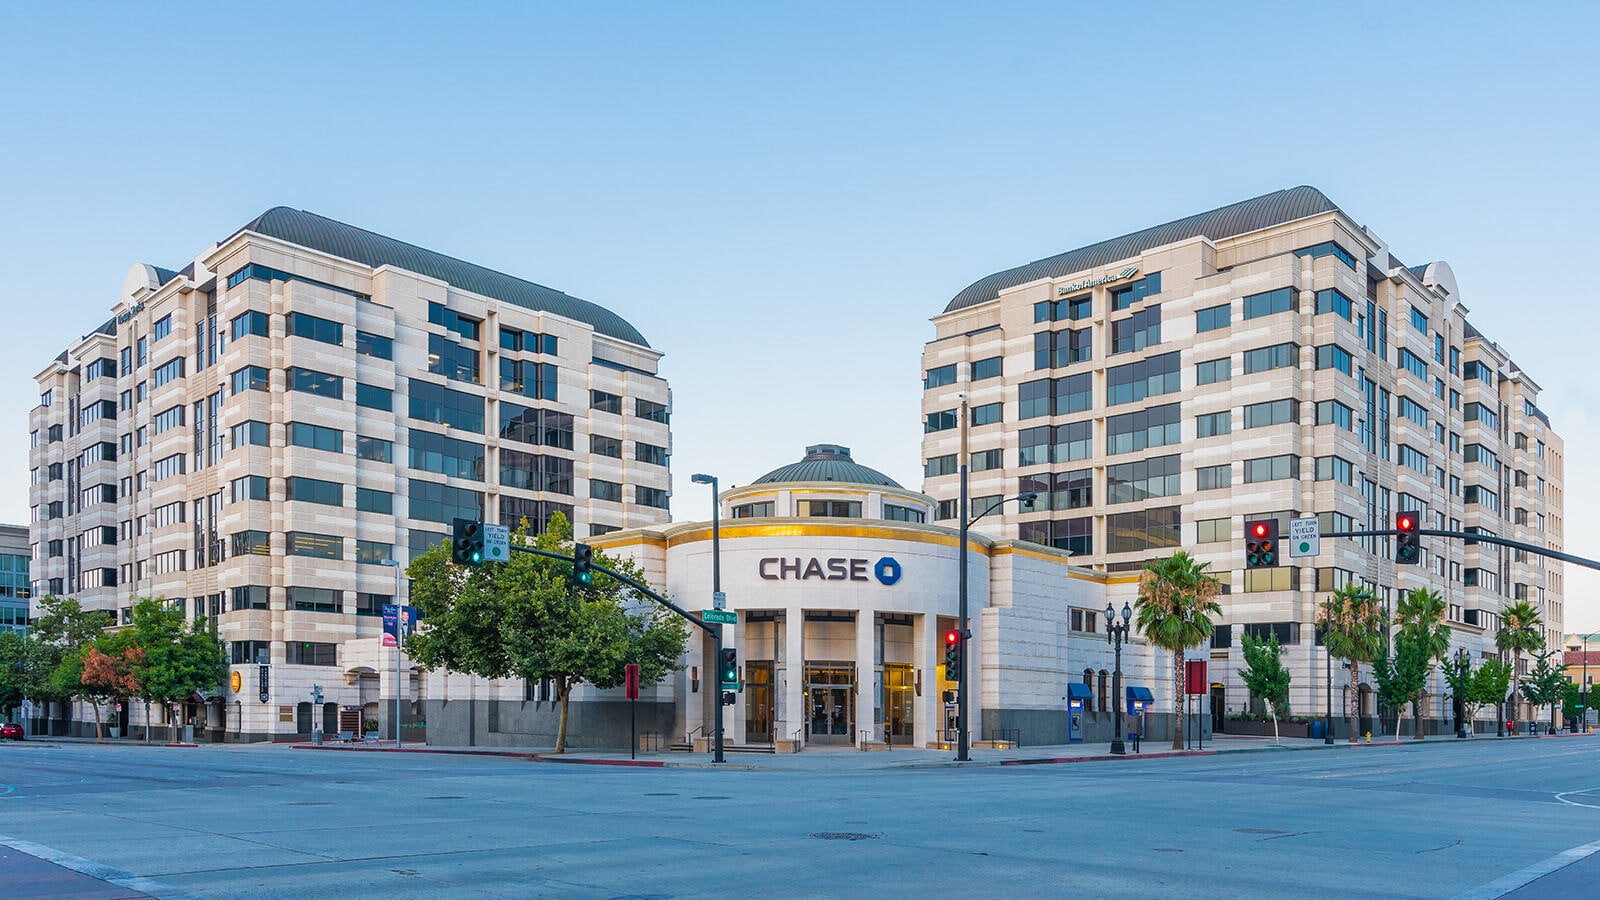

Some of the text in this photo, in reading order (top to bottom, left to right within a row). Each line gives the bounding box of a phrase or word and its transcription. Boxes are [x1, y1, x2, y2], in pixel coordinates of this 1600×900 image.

[1058, 284, 1077, 295] Bank
[1086, 275, 1117, 288] America
[759, 557, 869, 581] CHASE
[703, 613, 736, 622] Colorado Blvd
